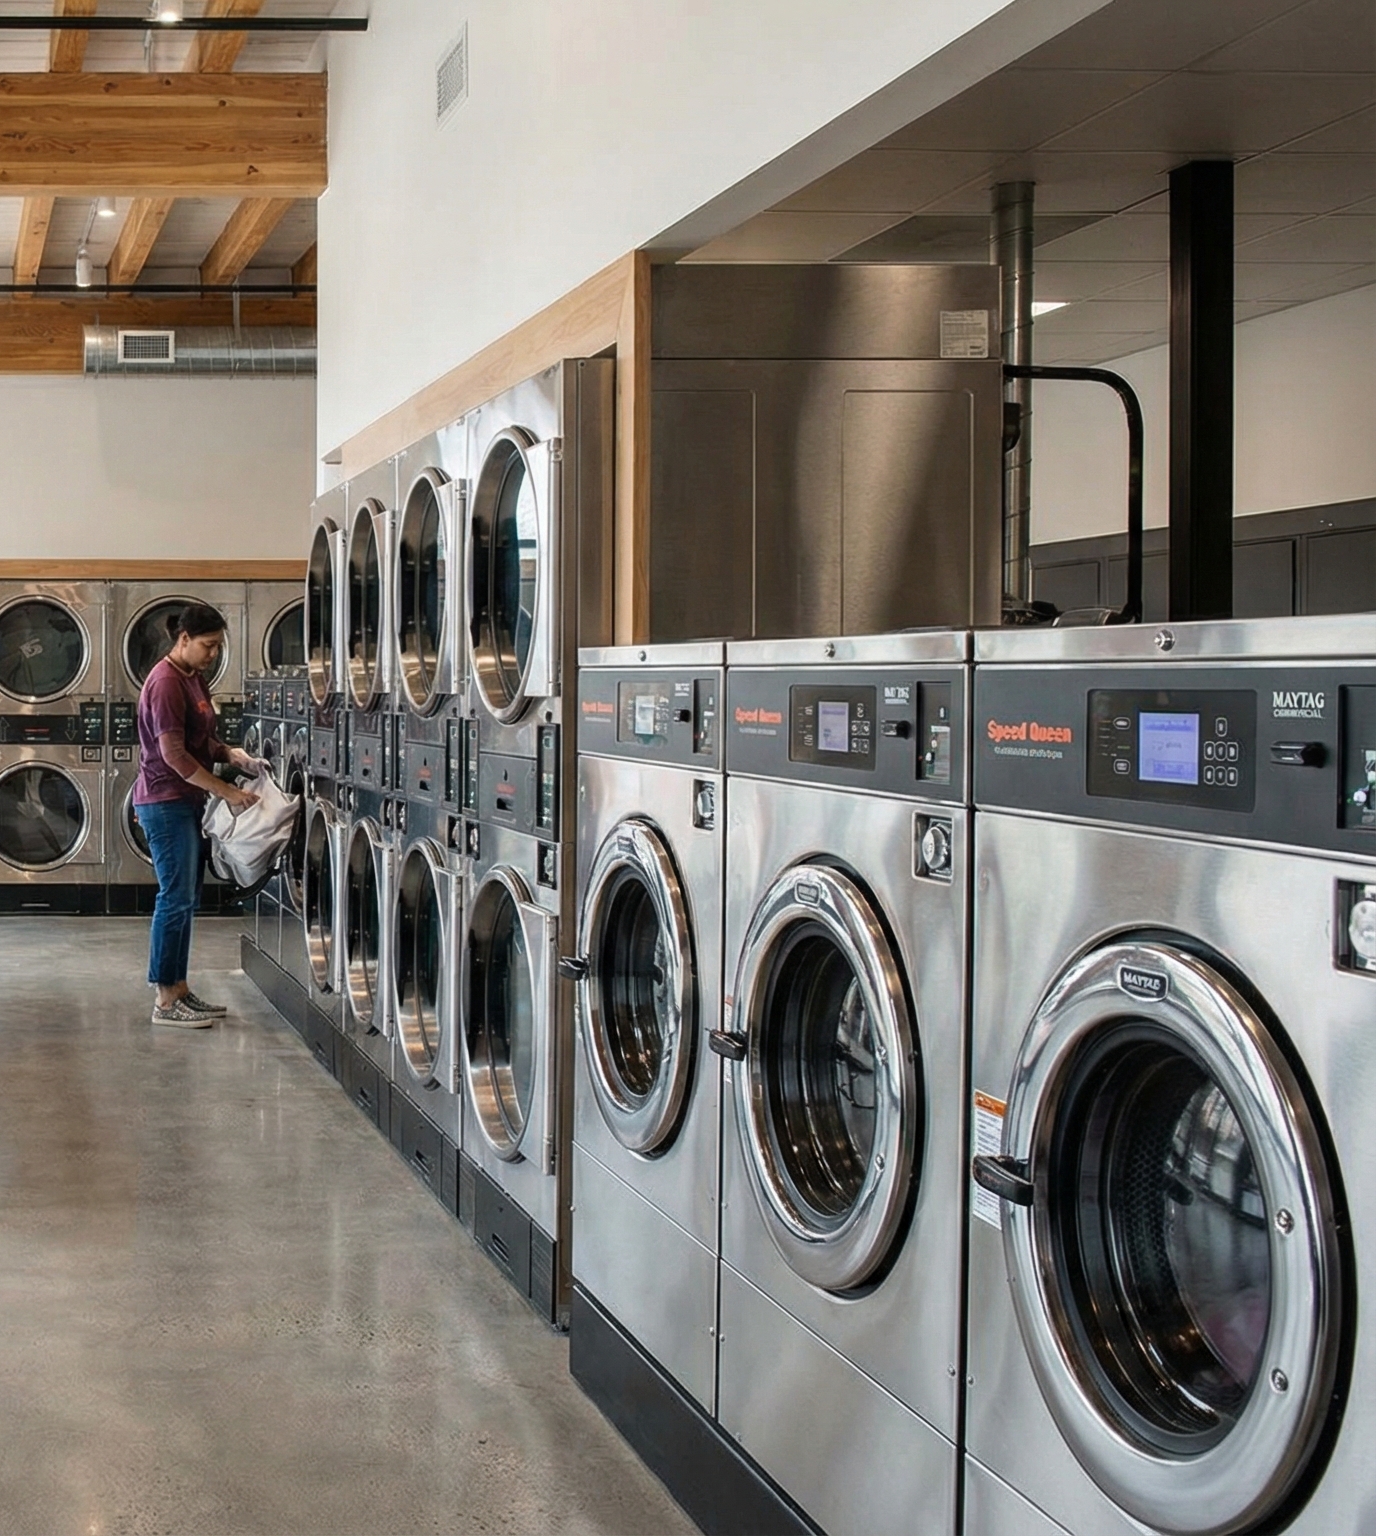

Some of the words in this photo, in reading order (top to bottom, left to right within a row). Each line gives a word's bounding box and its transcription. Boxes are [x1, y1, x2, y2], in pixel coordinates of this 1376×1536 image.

[1272, 691, 1325, 709] MAYTAG
[987, 719, 1027, 743] Speed
[1029, 721, 1072, 743] Queen
